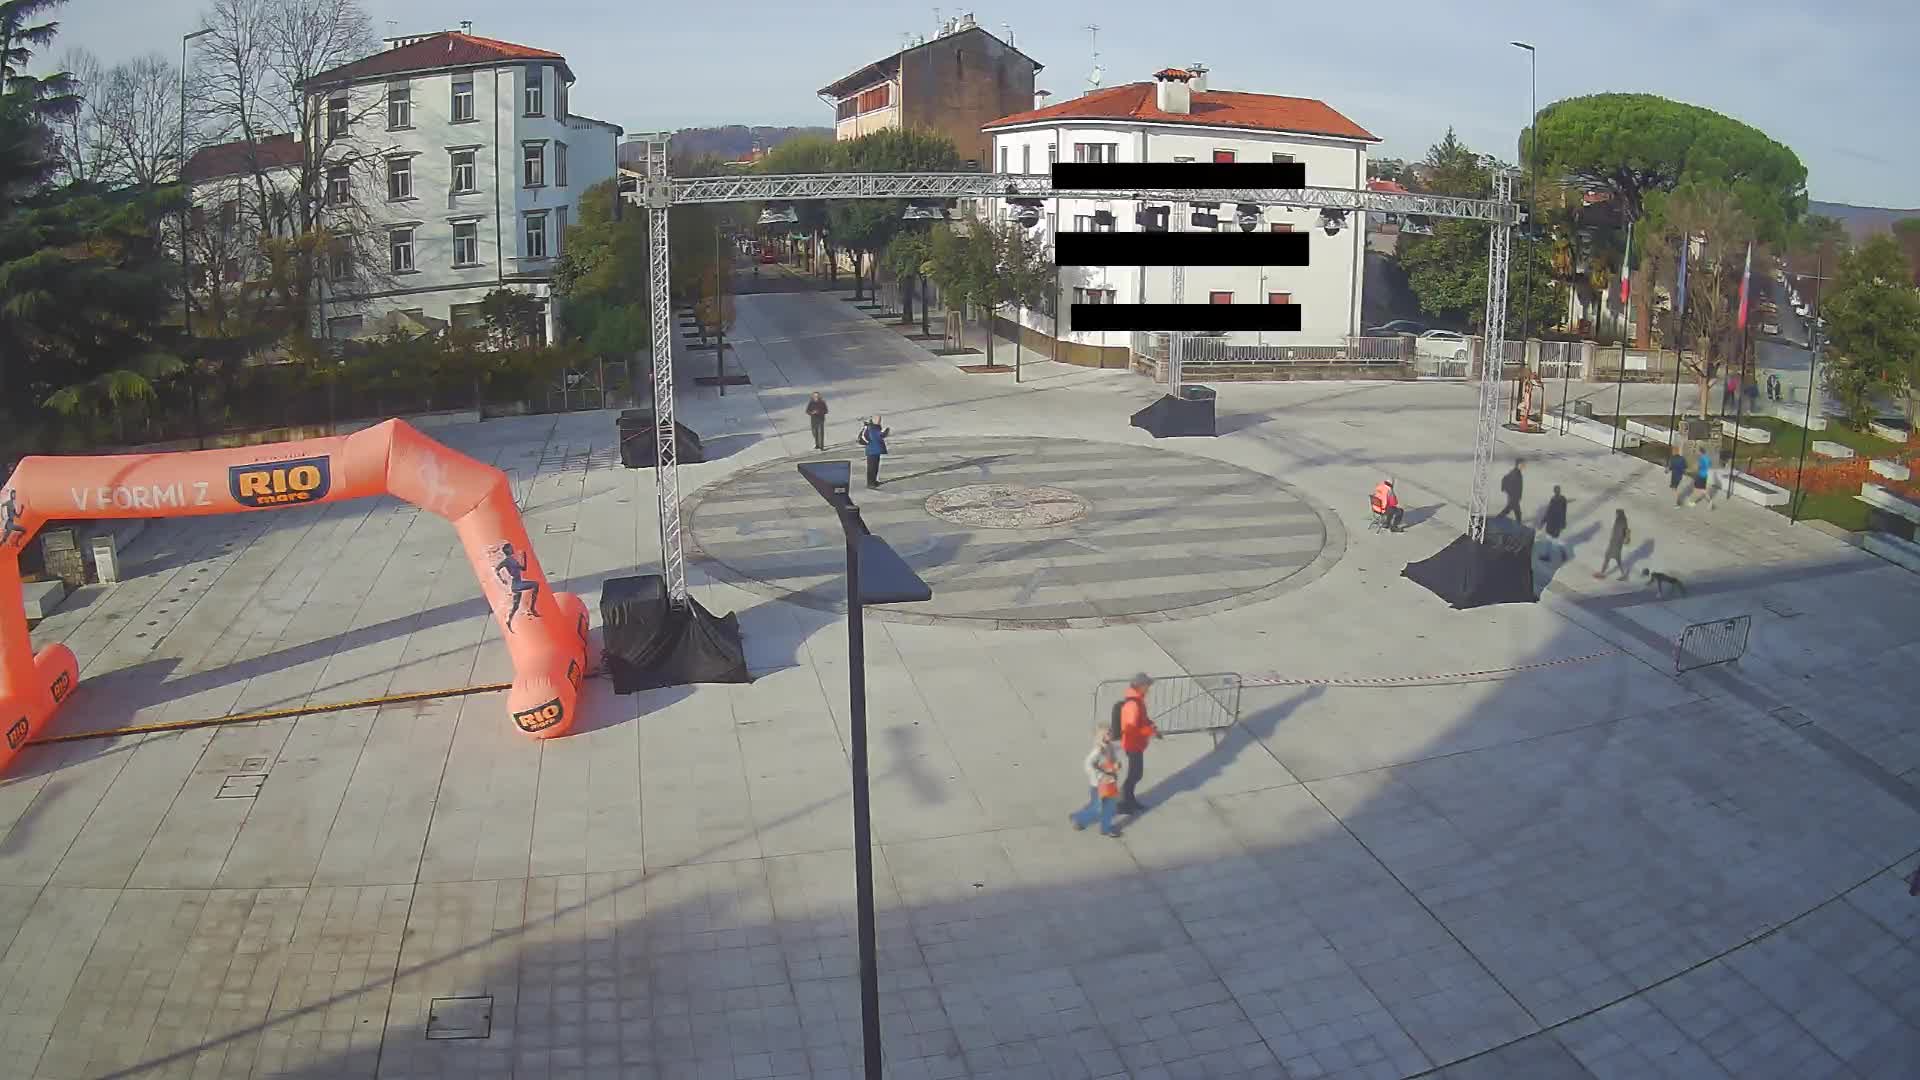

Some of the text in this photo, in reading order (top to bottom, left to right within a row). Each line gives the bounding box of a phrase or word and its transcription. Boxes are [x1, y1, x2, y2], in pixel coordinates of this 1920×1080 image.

[240, 465, 320, 497] RIO
[71, 480, 213, 511] V FORMI Z
[256, 491, 310, 504] mare
[519, 704, 560, 727] RIO
